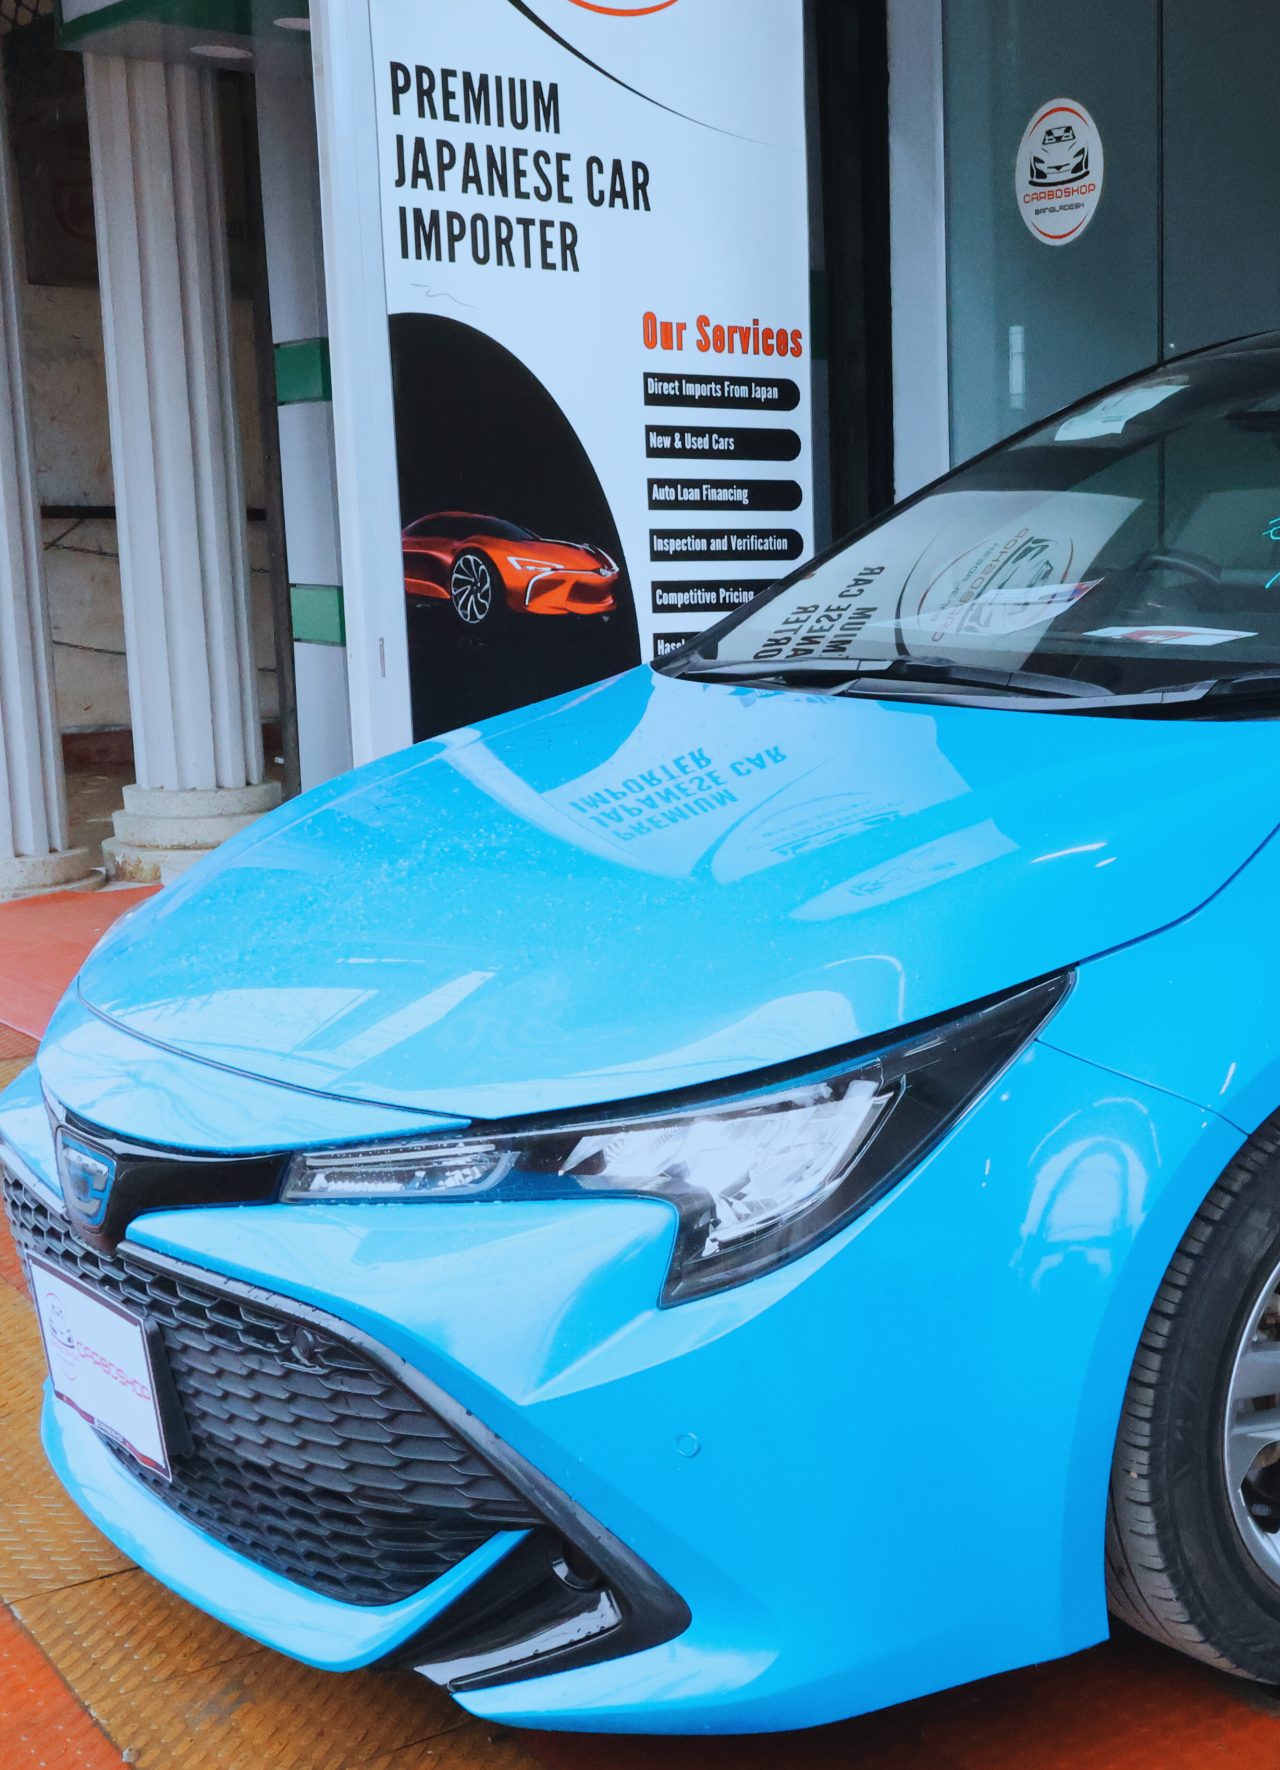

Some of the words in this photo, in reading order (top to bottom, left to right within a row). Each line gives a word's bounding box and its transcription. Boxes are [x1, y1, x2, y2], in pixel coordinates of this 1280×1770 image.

[389, 61, 561, 134] PREMIUM
[394, 134, 573, 204] JAPANESE
[586, 155, 651, 212] CAR
[398, 206, 580, 272] IMPORTER
[643, 311, 687, 351] Our
[696, 315, 803, 358] Services
[647, 377, 680, 395] Direct
[682, 379, 722, 399] Imports
[724, 381, 749, 398] From
[751, 382, 779, 401] Japan
[649, 432, 671, 449] New
[673, 432, 682, 449] &
[684, 433, 710, 450] Used
[712, 434, 735, 450] Cars
[652, 484, 676, 501] Auto
[677, 484, 701, 501] Loan
[702, 485, 749, 504] Financing
[653, 535, 707, 554] Inspection
[710, 535, 728, 551] and
[730, 534, 788, 551] Verification
[655, 588, 717, 608] Competitive
